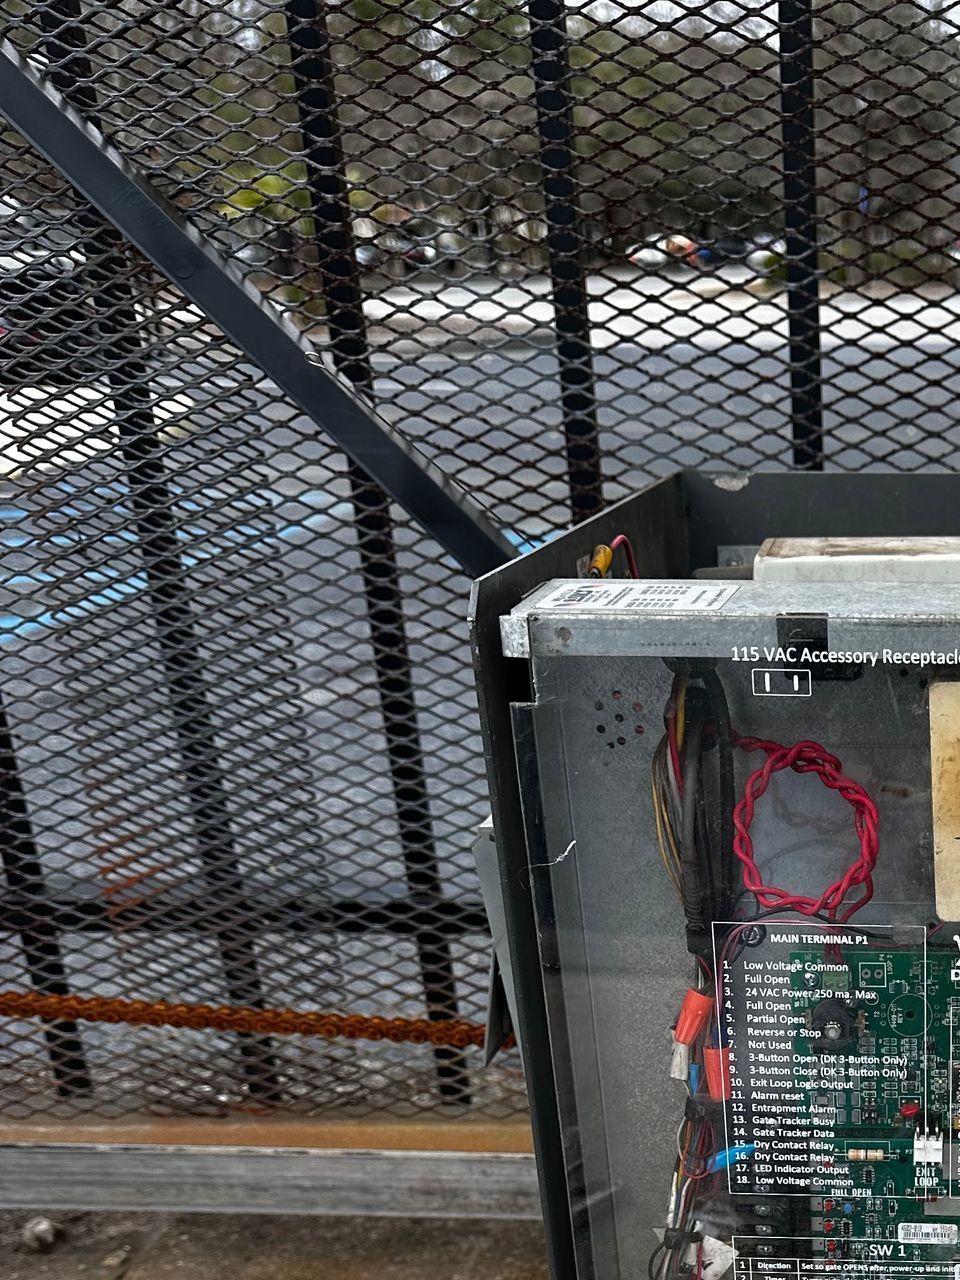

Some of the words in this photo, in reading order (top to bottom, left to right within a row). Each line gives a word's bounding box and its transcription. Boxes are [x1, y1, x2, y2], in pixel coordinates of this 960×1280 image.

[731, 646, 759, 661] 115
[764, 648, 797, 662] VAC
[801, 648, 878, 667] Accessory
[770, 934, 799, 943] MAIN
[801, 934, 853, 944] TERMINAL
[855, 936, 868, 944] P1
[723, 961, 732, 970] 1.
[744, 962, 763, 970] Low
[765, 961, 802, 972] Voltage
[805, 963, 848, 971] Common
[724, 975, 733, 983] 2.
[745, 975, 762, 983] Full
[764, 976, 790, 986] Open
[724, 988, 733, 996] 3.
[746, 989, 758, 997] 24
[759, 989, 779, 997] VAC
[782, 990, 812, 998] Power
[815, 990, 833, 998] 250
[835, 991, 852, 999] ma.
[855, 991, 876, 1000] Max
[747, 1015, 779, 1024] Partial
[782, 1015, 805, 1026] Open
[727, 1027, 736, 1035] 6.
[748, 1028, 784, 1036] Reverse
[800, 1029, 821, 1040] Stop
[728, 1040, 737, 1048] 7.
[749, 1041, 766, 1049] Not
[769, 1041, 792, 1049] Used
[749, 1054, 790, 1063] 3-Button
[792, 1054, 818, 1065] Open
[820, 1055, 836, 1064] (DK
[839, 1055, 881, 1065] 3-Button
[883, 1056, 908, 1066] Only)
[732, 1091, 745, 1099] 11.
[751, 1092, 782, 1100] Alarm
[784, 1093, 805, 1101] reset
[732, 1104, 746, 1112] 12.
[752, 1104, 806, 1115] Entrapment
[809, 1105, 835, 1113] Alarm
[734, 1128, 747, 1136] 14.
[754, 1129, 775, 1137] Gate
[777, 1129, 811, 1137] Tracker
[814, 1130, 835, 1138] Data
[754, 1141, 769, 1150] Dry
[772, 1141, 807, 1149] Contact
[810, 1142, 834, 1152] Relay
[755, 1165, 772, 1173] LED
[775, 1165, 818, 1173] Indicator
[820, 1166, 849, 1175] Output
[916, 1167, 935, 1176] EXIT
[915, 1177, 939, 1186] LOOP
[869, 1245, 893, 1256] SW
[898, 1245, 906, 1256] 1
